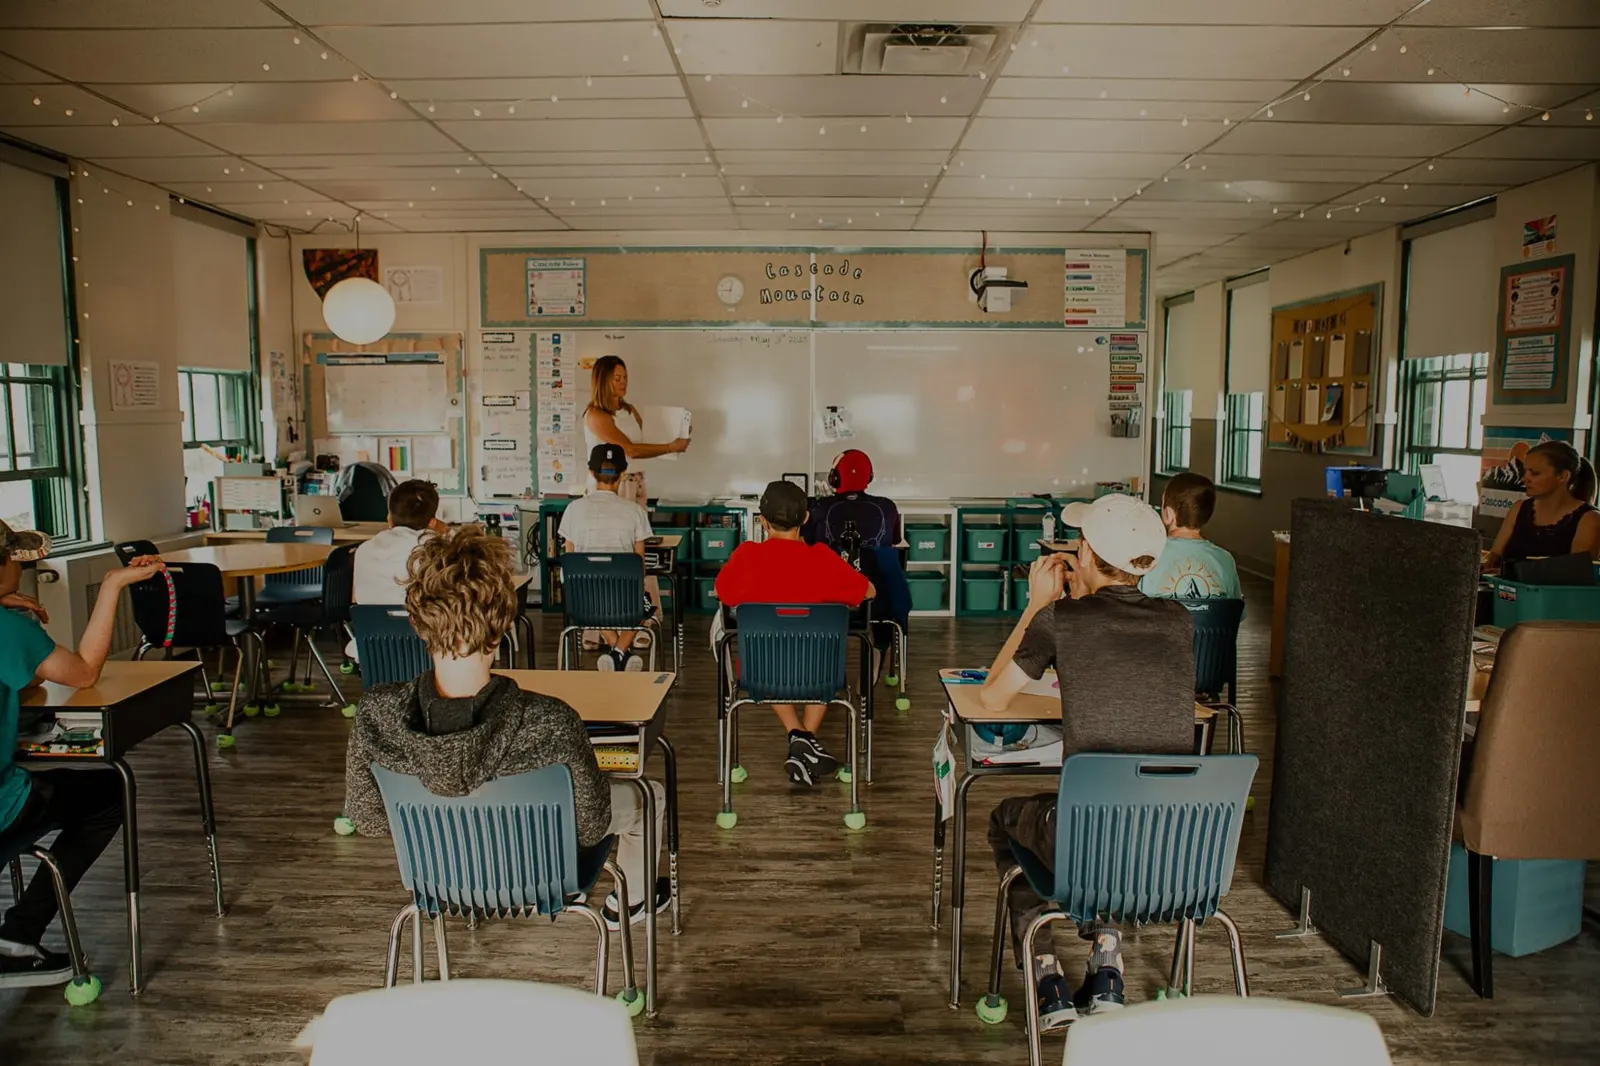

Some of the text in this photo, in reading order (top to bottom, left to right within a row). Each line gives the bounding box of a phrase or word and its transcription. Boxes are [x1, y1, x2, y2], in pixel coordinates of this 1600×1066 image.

[765, 259, 862, 280] Cascade
[760, 284, 865, 305] Mountain
[1481, 494, 1513, 508] Cascade
